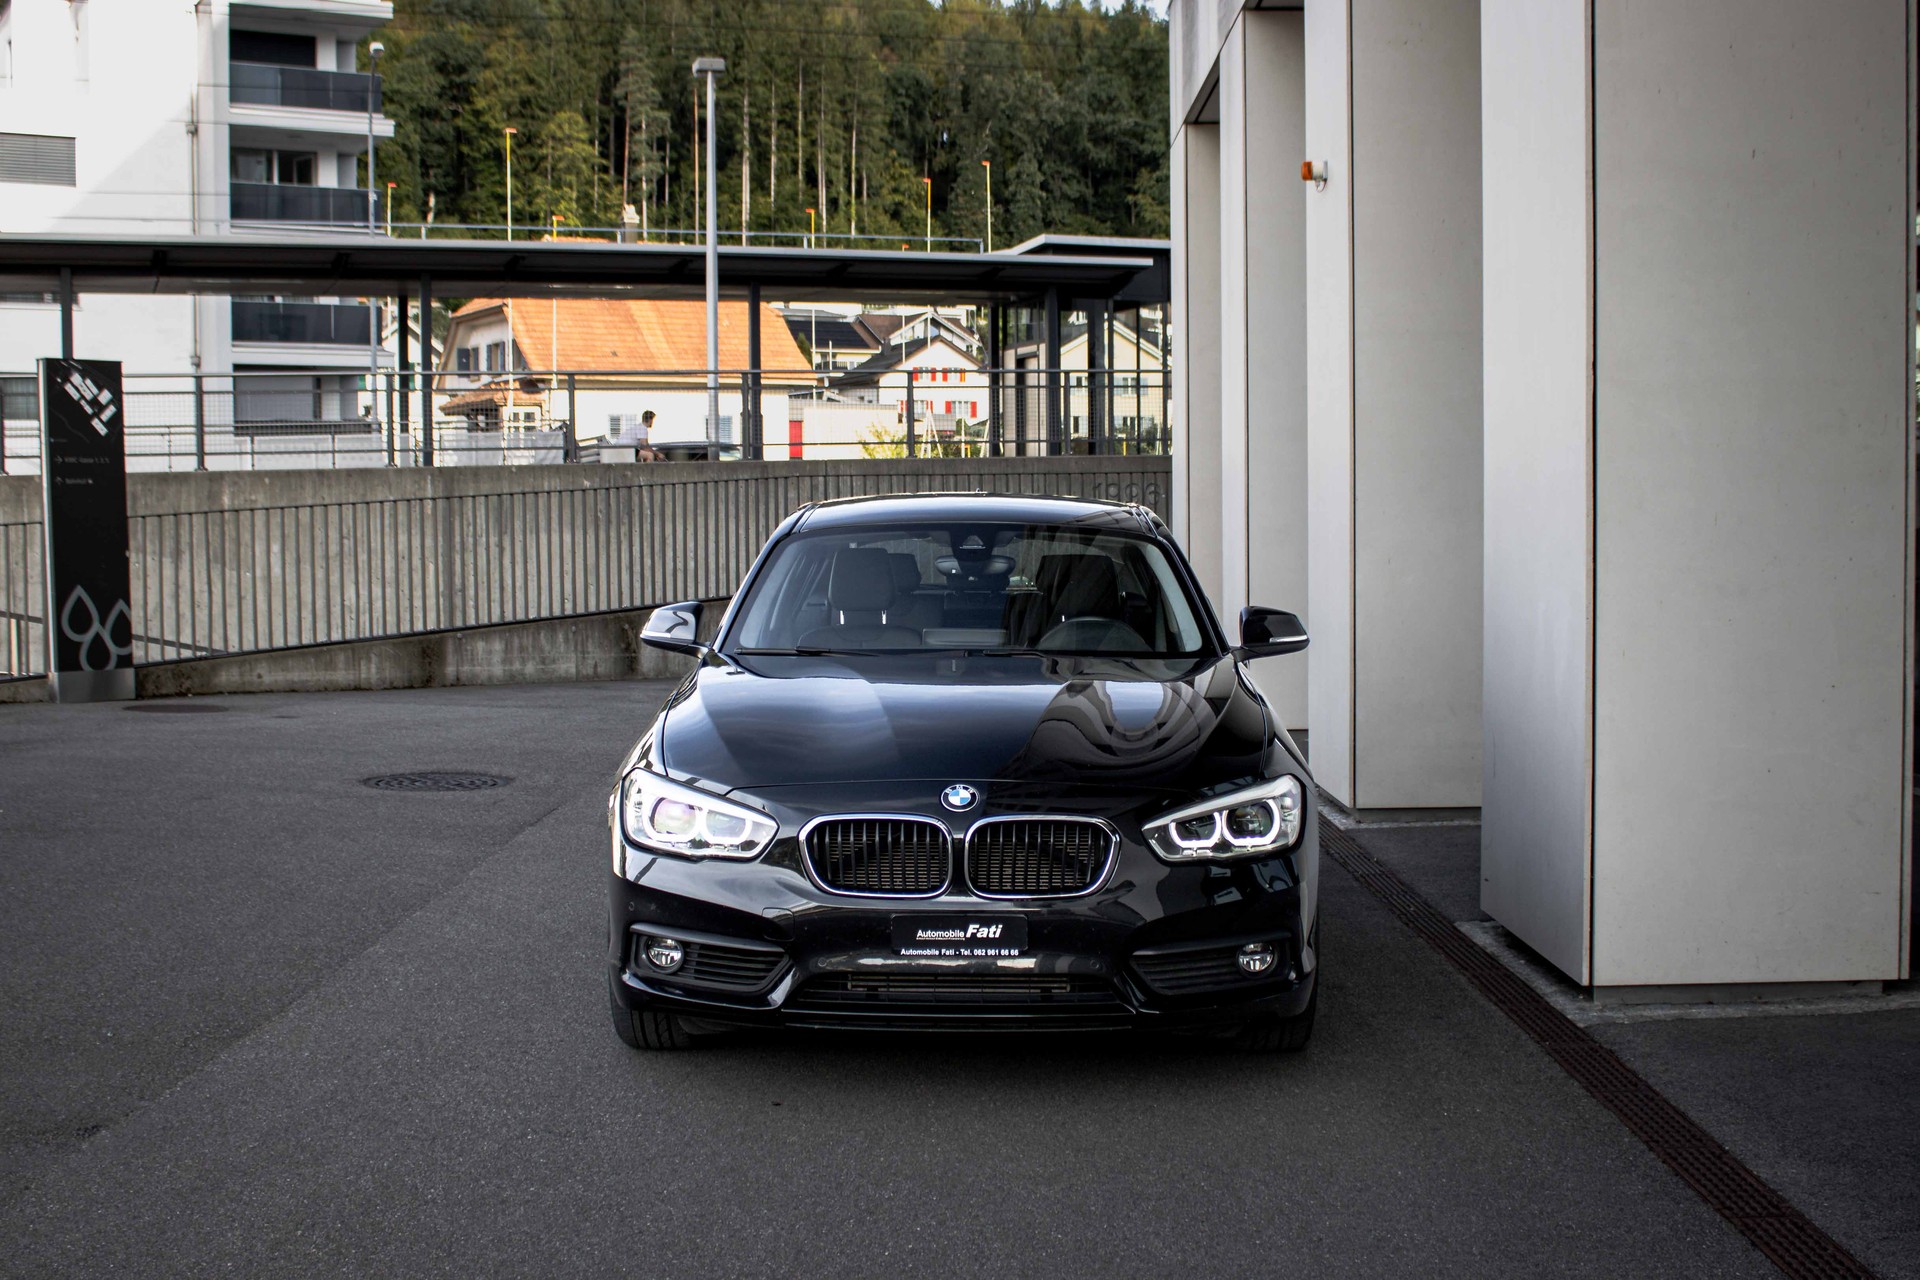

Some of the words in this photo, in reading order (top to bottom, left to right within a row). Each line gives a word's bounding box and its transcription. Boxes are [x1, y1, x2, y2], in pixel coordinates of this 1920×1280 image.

[945, 784, 974, 794] BMW
[916, 929, 965, 938] Automobile
[965, 924, 1003, 938] Fati
